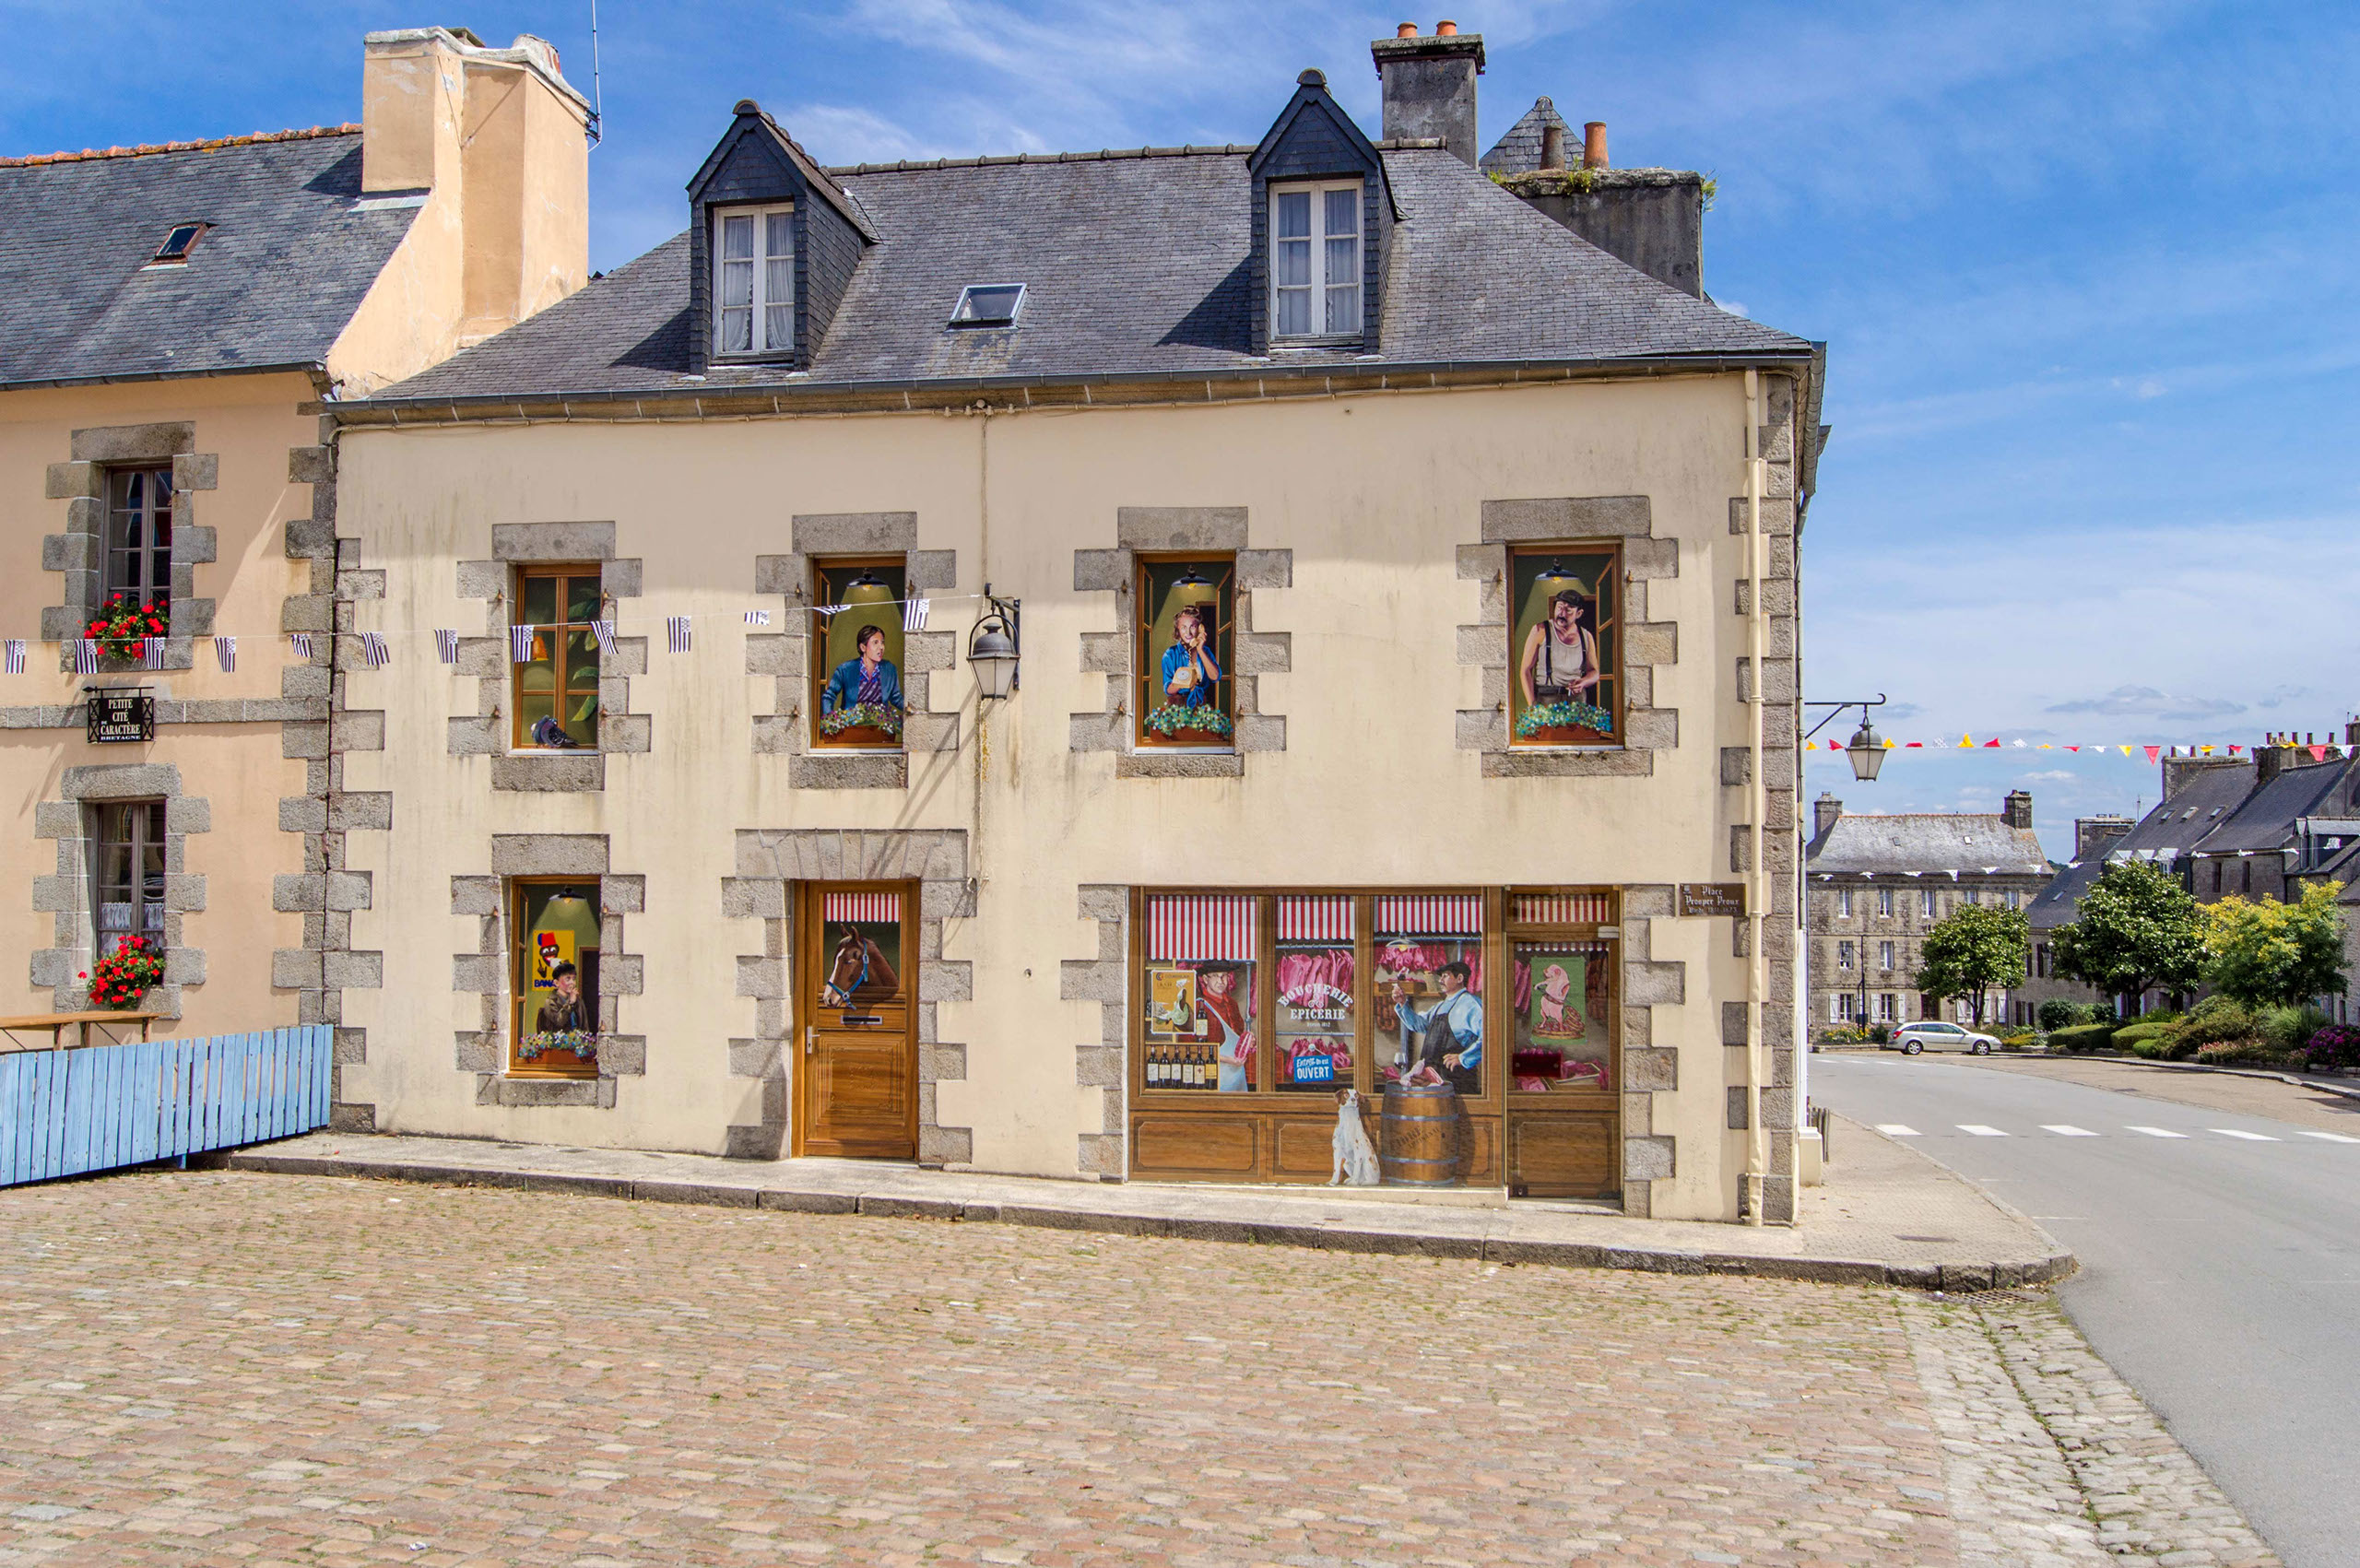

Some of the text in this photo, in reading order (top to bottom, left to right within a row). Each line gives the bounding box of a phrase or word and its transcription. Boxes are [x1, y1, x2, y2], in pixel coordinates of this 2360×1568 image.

[108, 699, 134, 709] PETITE
[112, 709, 129, 722] CITÉ
[100, 722, 140, 736] CARACTÈRE
[1701, 885, 1723, 895] Place
[1685, 895, 1715, 906] Prosper
[534, 979, 558, 987] BANA
[1277, 984, 1354, 1008] BOUCHERIE
[1291, 1008, 1346, 1020] EPICERIE
[1296, 1066, 1329, 1079] OUVERT
